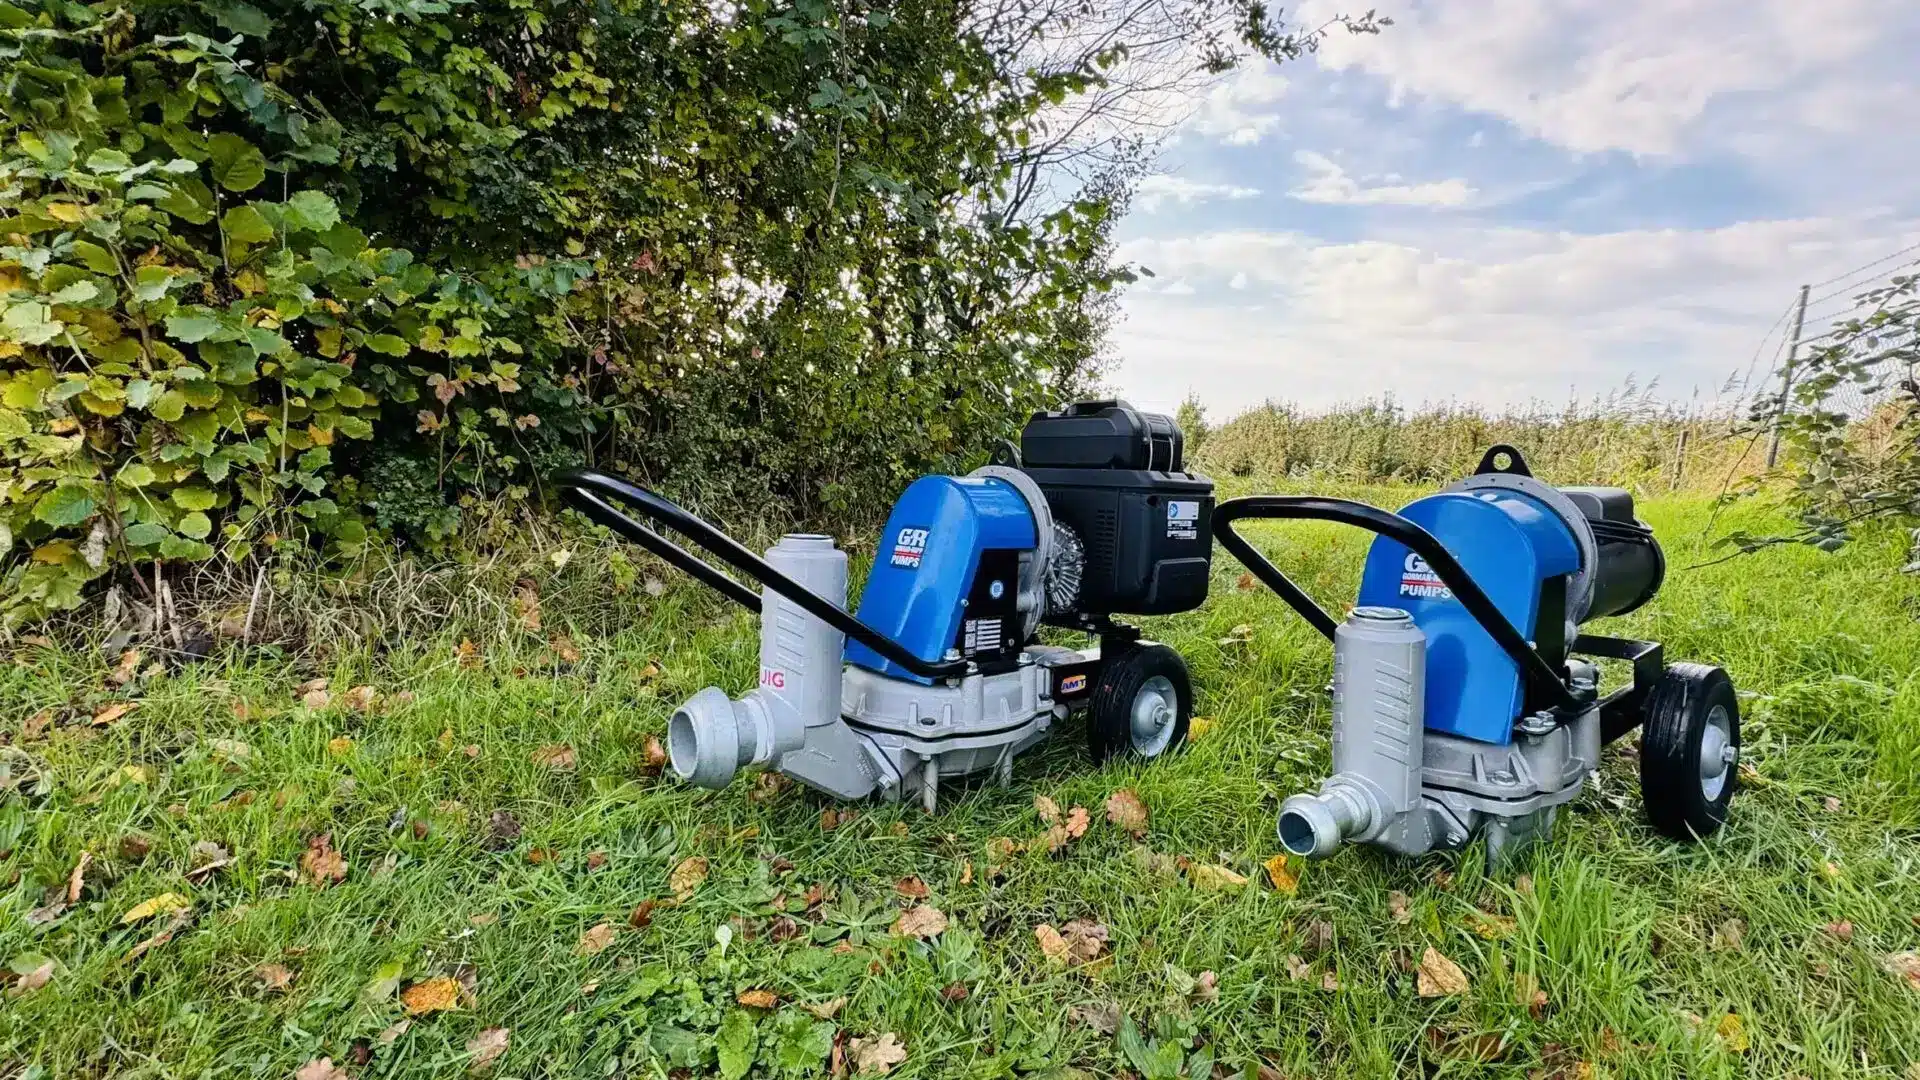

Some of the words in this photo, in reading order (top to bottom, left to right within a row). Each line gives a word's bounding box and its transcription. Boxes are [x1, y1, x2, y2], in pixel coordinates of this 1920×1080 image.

[898, 528, 929, 547] GR
[890, 554, 920, 568] PUMPS
[1400, 584, 1452, 599] PUMPS
[1062, 679, 1086, 690] AMT
